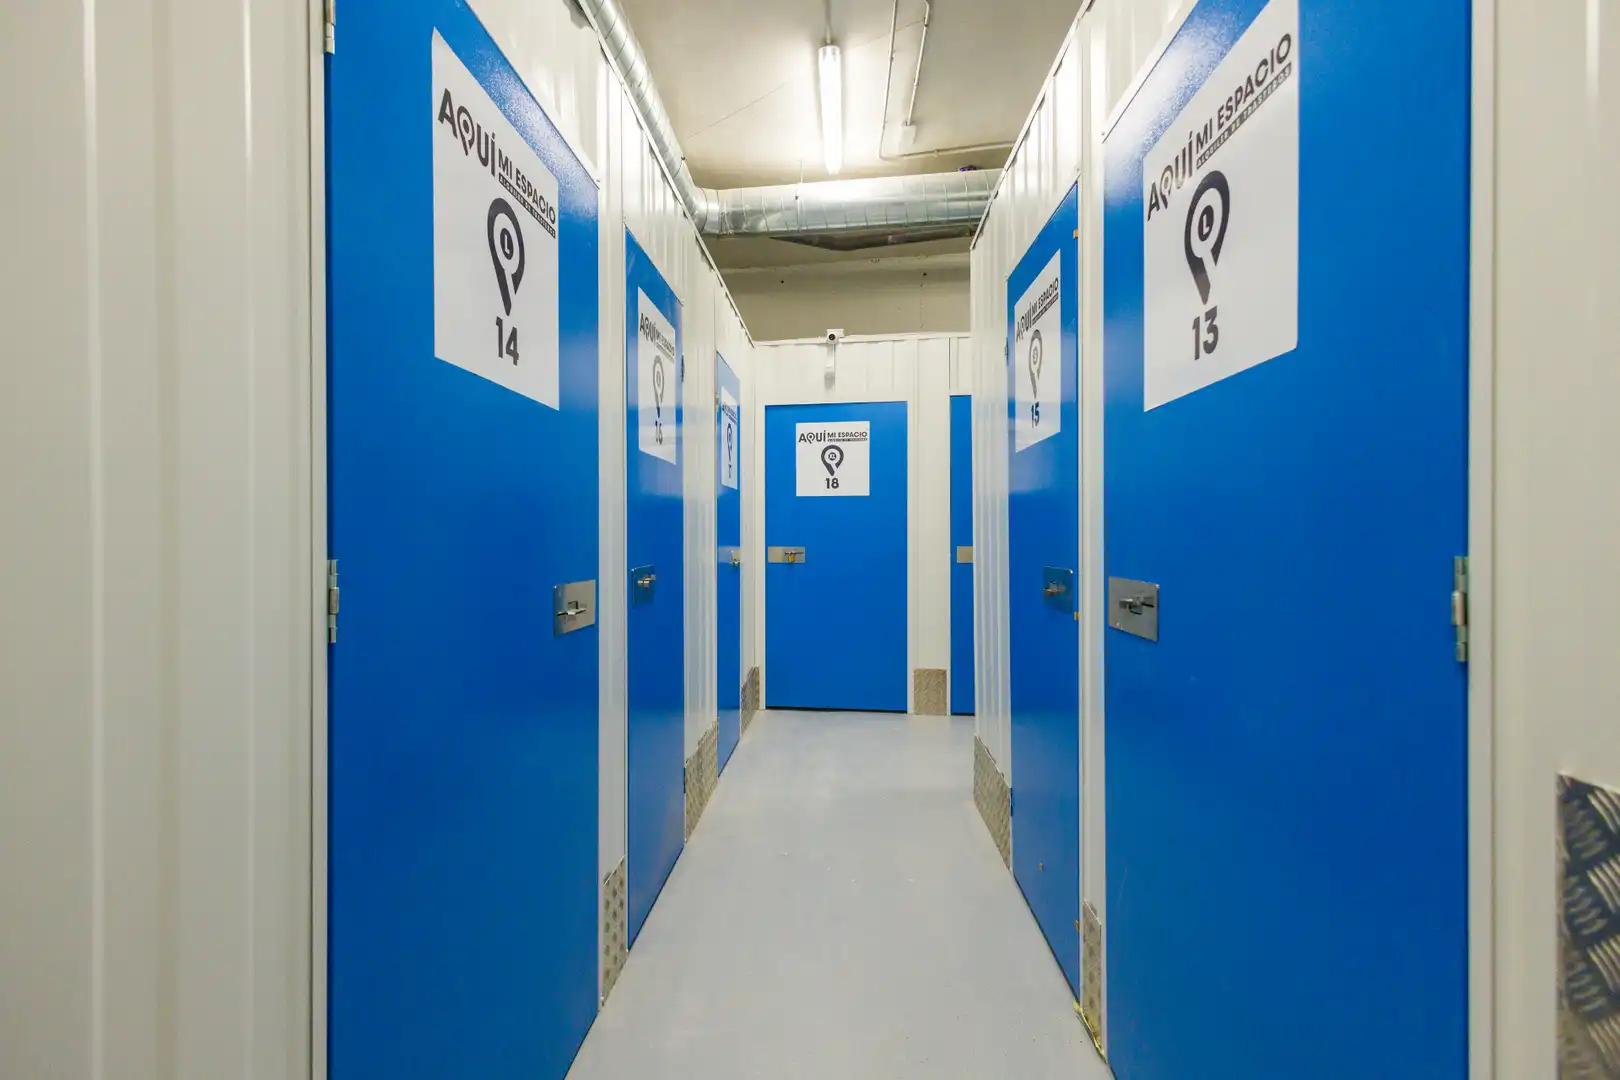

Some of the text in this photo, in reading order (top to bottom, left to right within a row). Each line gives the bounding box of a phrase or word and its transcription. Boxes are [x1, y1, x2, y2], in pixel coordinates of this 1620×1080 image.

[1147, 33, 1292, 221] AQUÍ MI ESPACIO
[438, 88, 556, 225] AQUÍ MI ESPACIO
[1038, 277, 1059, 310] ESPACIO
[495, 316, 519, 366] 14
[1192, 305, 1219, 361] 13
[1031, 401, 1040, 429] 15
[798, 430, 826, 444] AQUÍ
[825, 477, 840, 490] 18
